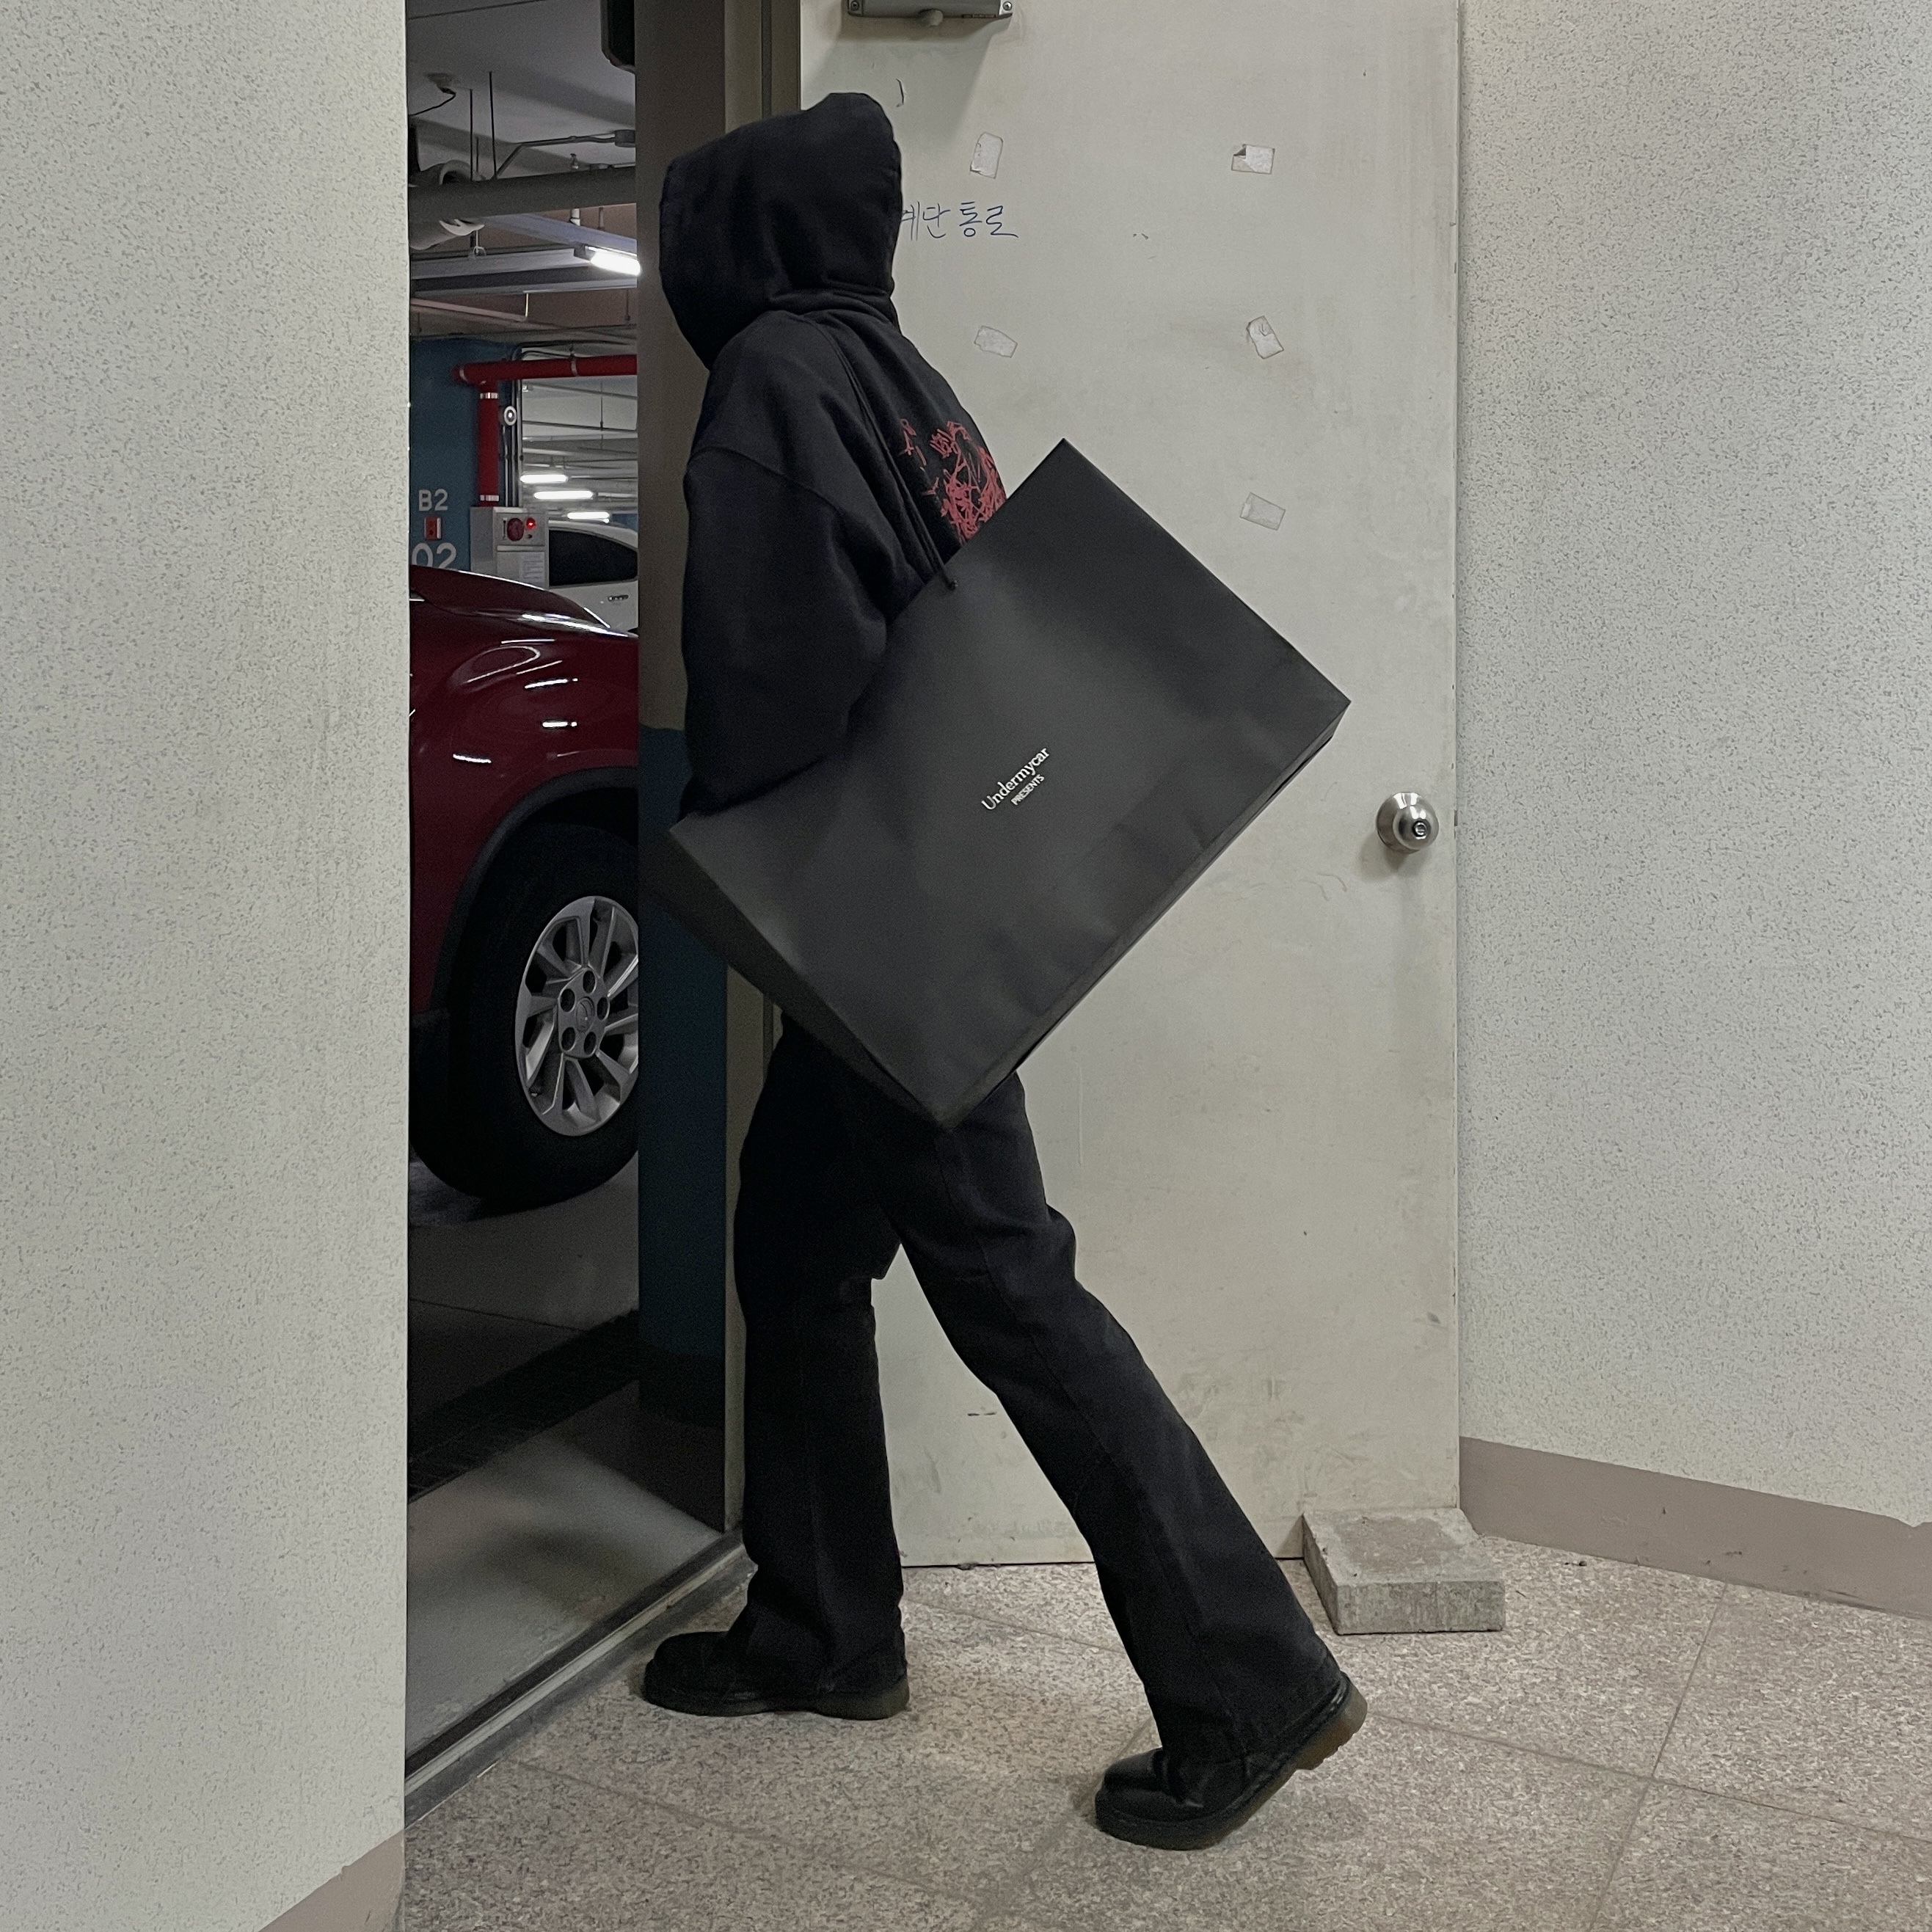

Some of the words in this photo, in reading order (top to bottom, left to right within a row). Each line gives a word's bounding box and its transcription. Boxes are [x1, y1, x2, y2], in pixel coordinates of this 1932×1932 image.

[959, 201, 1019, 238] 통로
[418, 489, 448, 511] B2
[412, 542, 457, 570] 02
[981, 748, 1050, 810] Undermycar
[1010, 773, 1045, 806] PRESENTS
